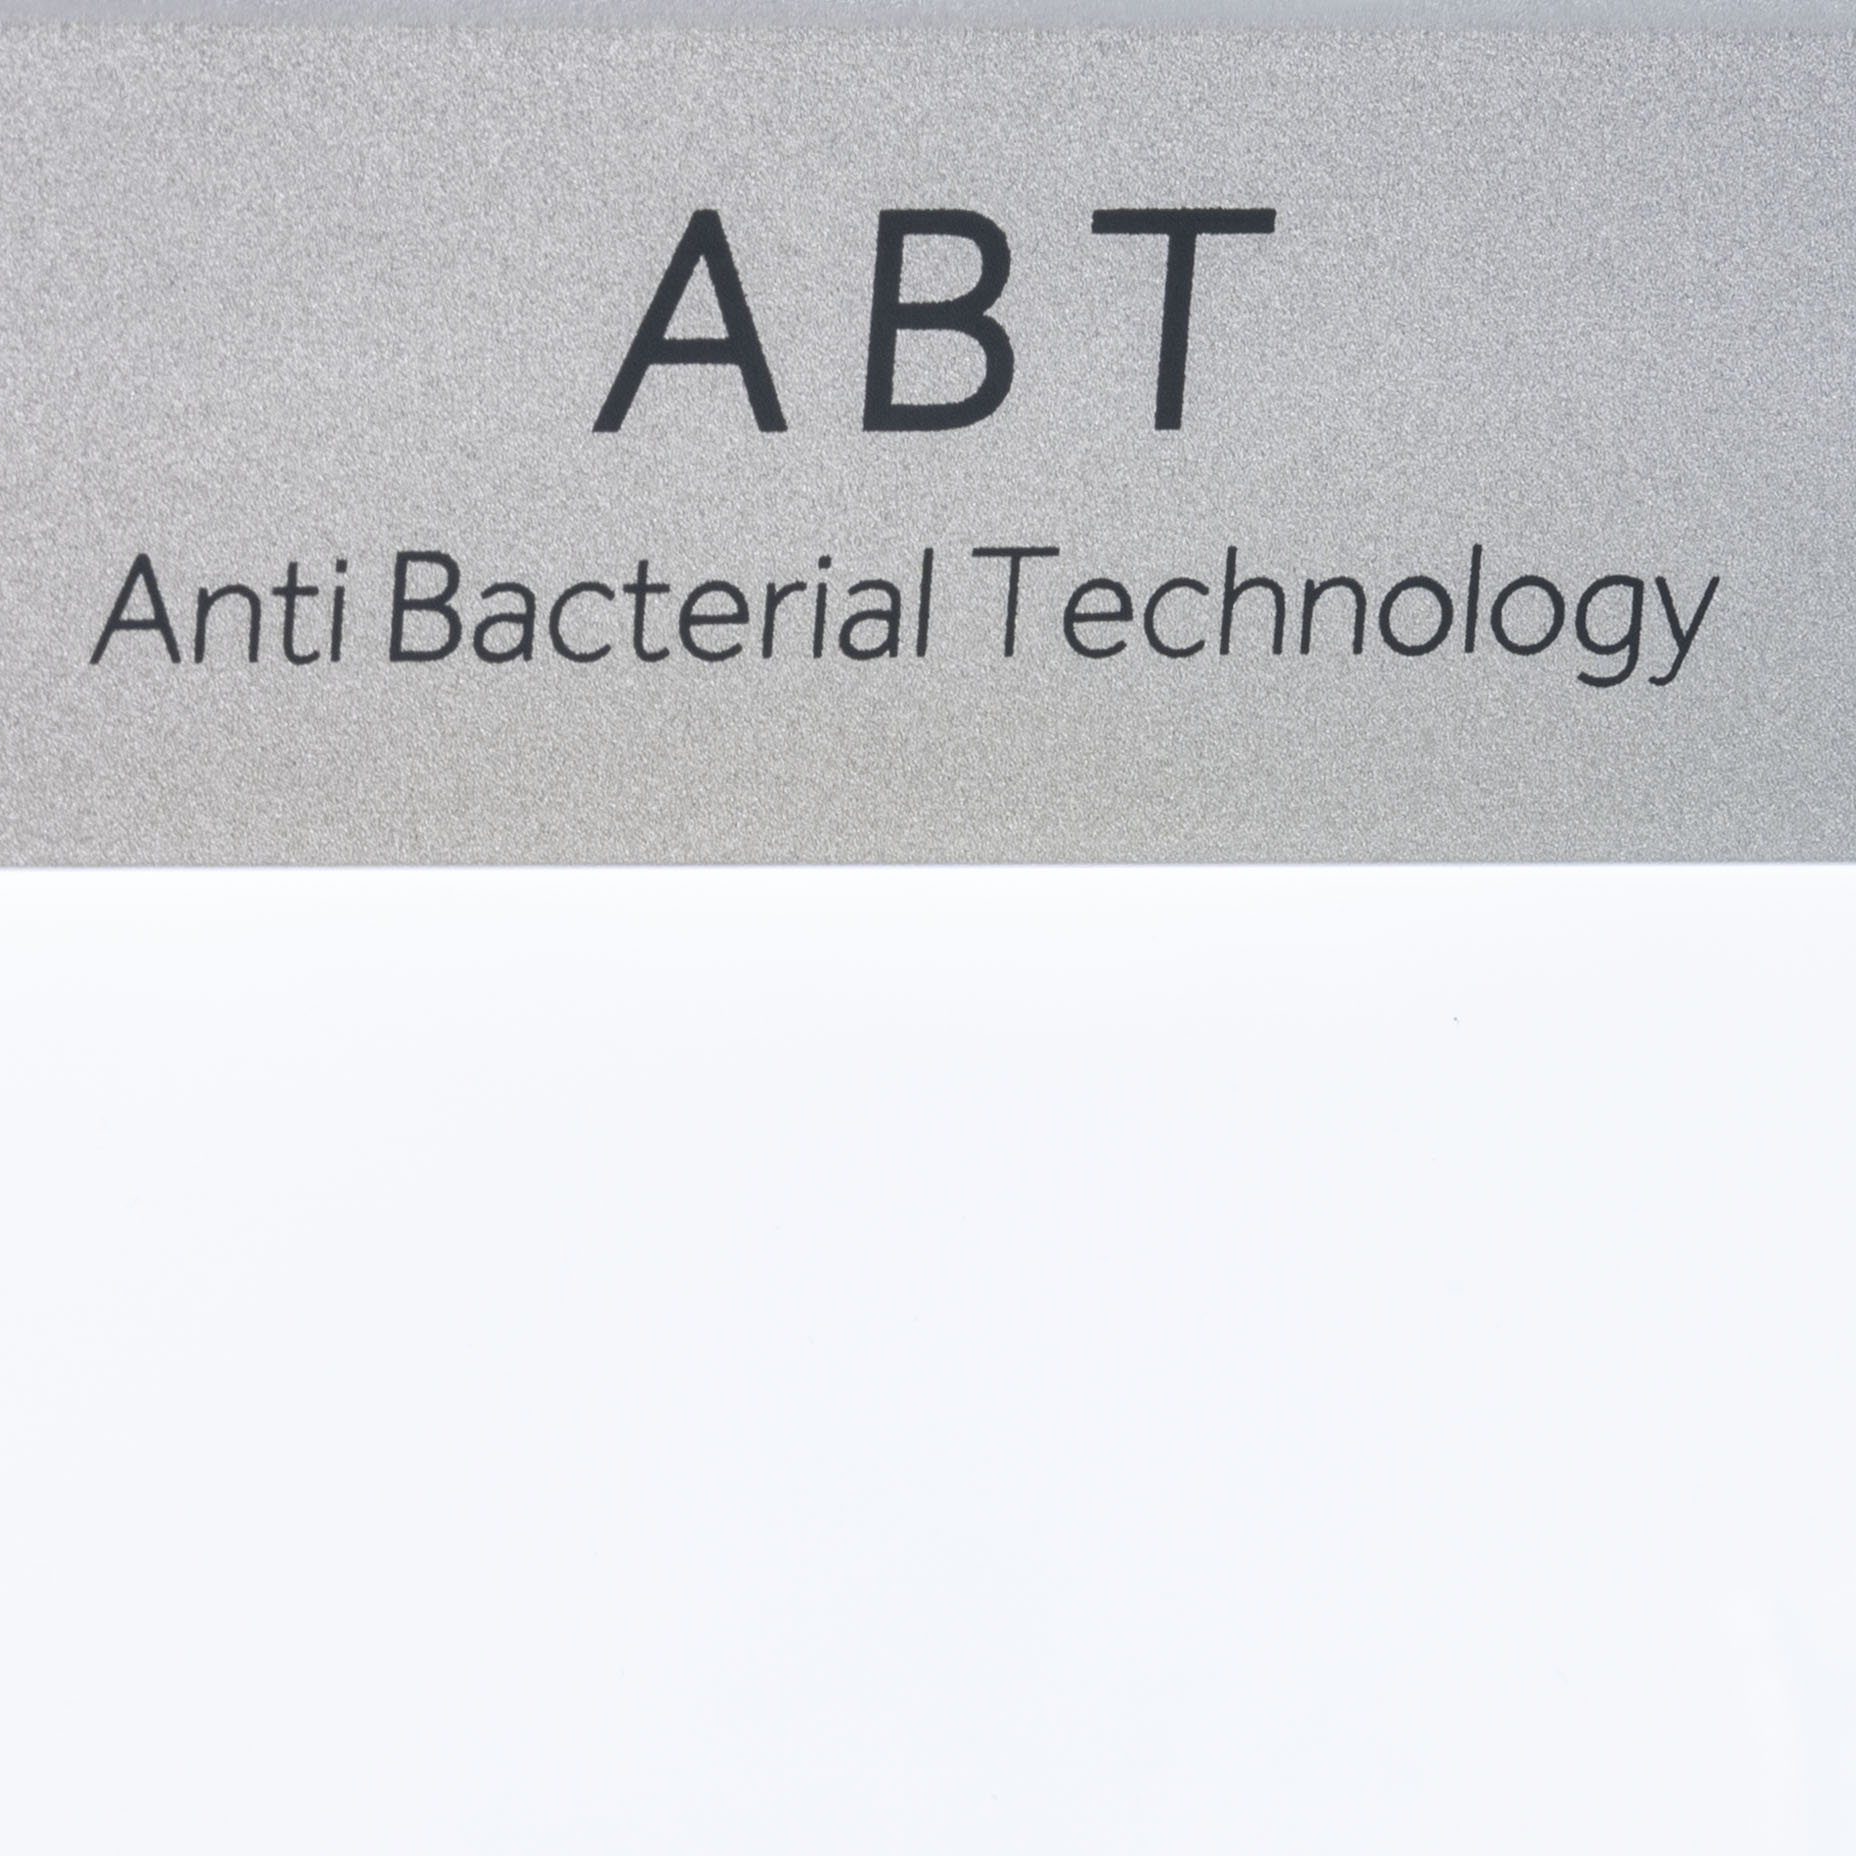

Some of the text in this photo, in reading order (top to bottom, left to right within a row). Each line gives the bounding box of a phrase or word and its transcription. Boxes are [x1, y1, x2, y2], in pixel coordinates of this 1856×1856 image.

[591, 207, 1278, 433] ABT
[89, 542, 1721, 690] Anti Bacterial Technology
